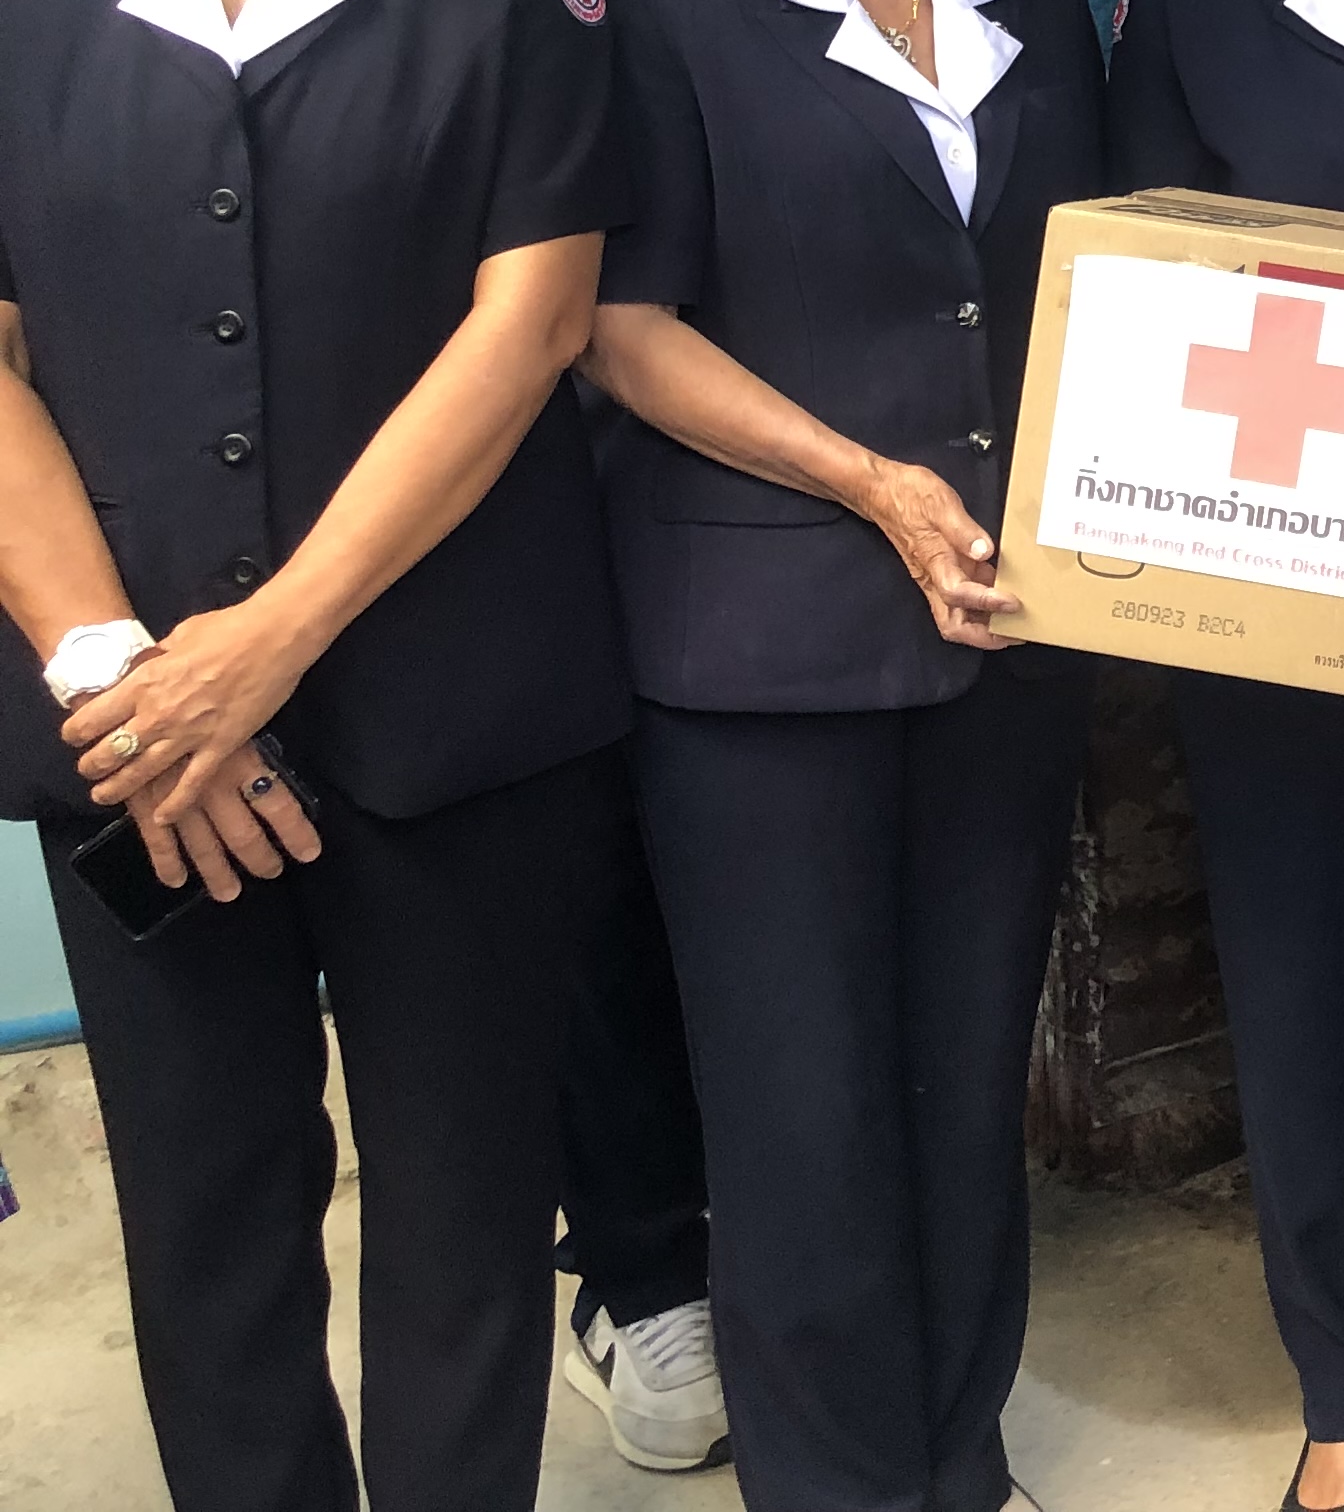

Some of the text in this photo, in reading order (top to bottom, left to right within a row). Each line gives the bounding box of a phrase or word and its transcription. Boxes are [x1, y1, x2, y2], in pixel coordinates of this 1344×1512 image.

[1074, 521, 1185, 555] Bangpakong
[1191, 541, 1226, 561] Red
[1232, 548, 1284, 570] Cross
[1111, 600, 1246, 639] 280923 B2C4
